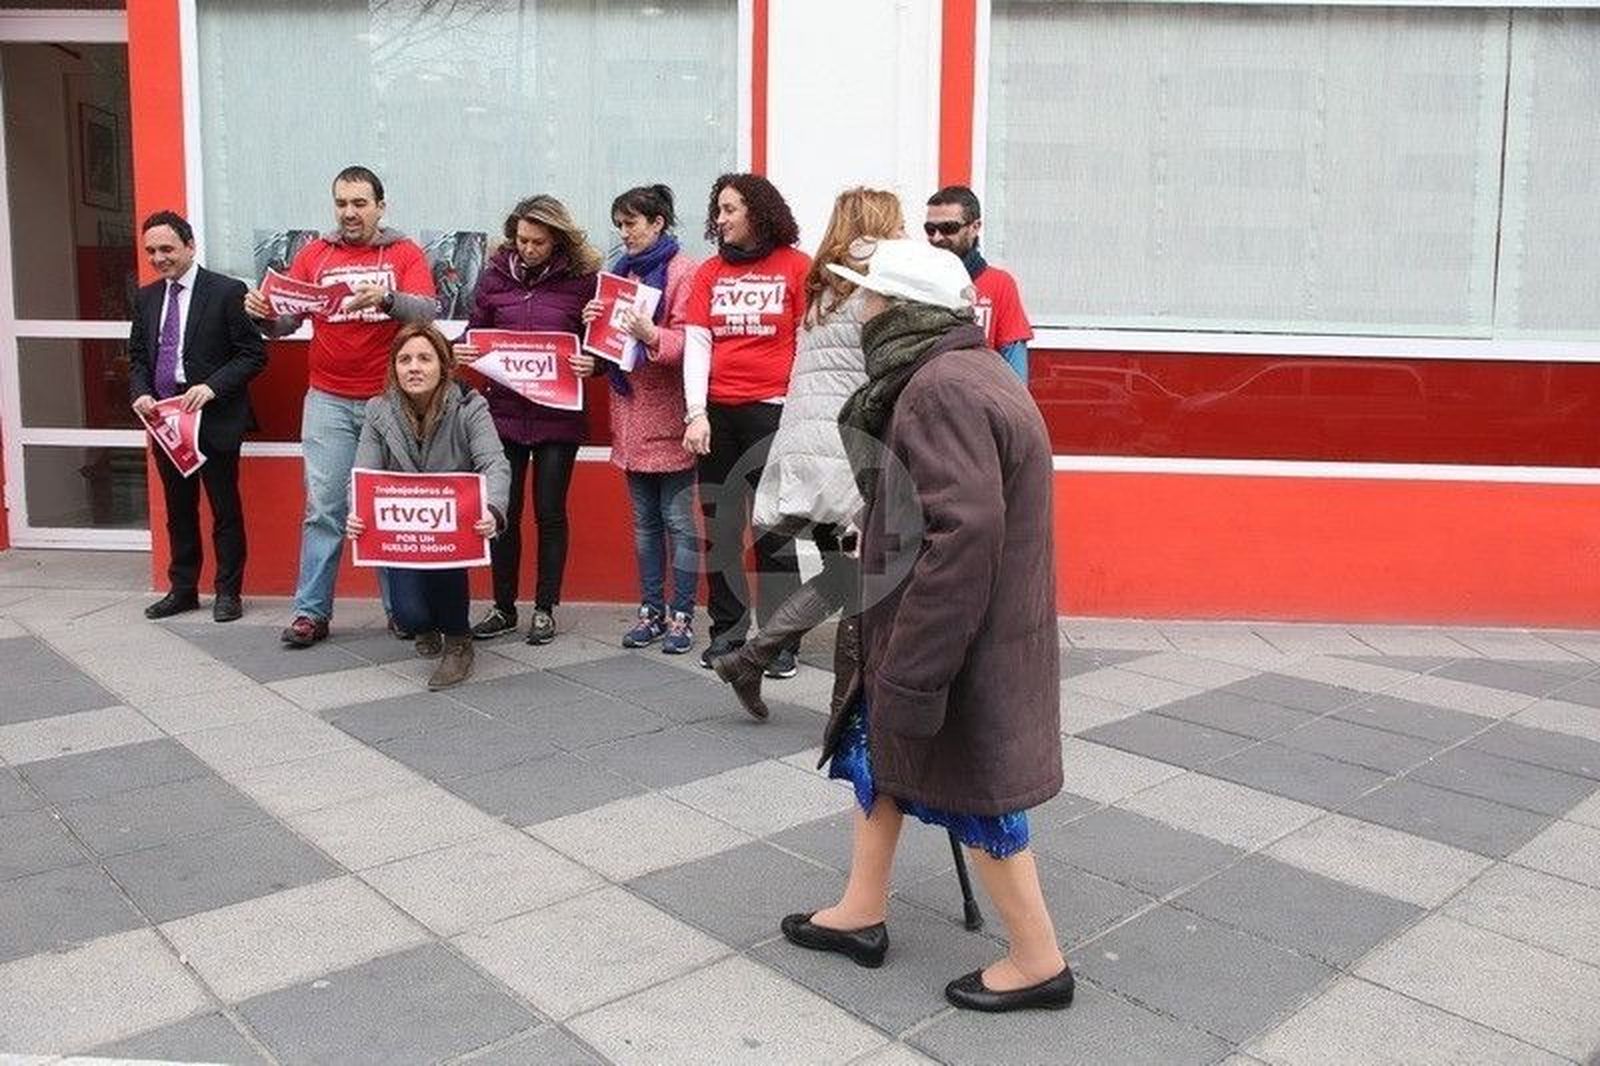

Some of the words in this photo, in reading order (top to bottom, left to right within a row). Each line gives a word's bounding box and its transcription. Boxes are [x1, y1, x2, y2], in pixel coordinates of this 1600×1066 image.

[499, 355, 553, 378] tvcyl
[380, 501, 451, 529] rtvcyl
[396, 533, 417, 543] POR
[419, 534, 435, 543] UN
